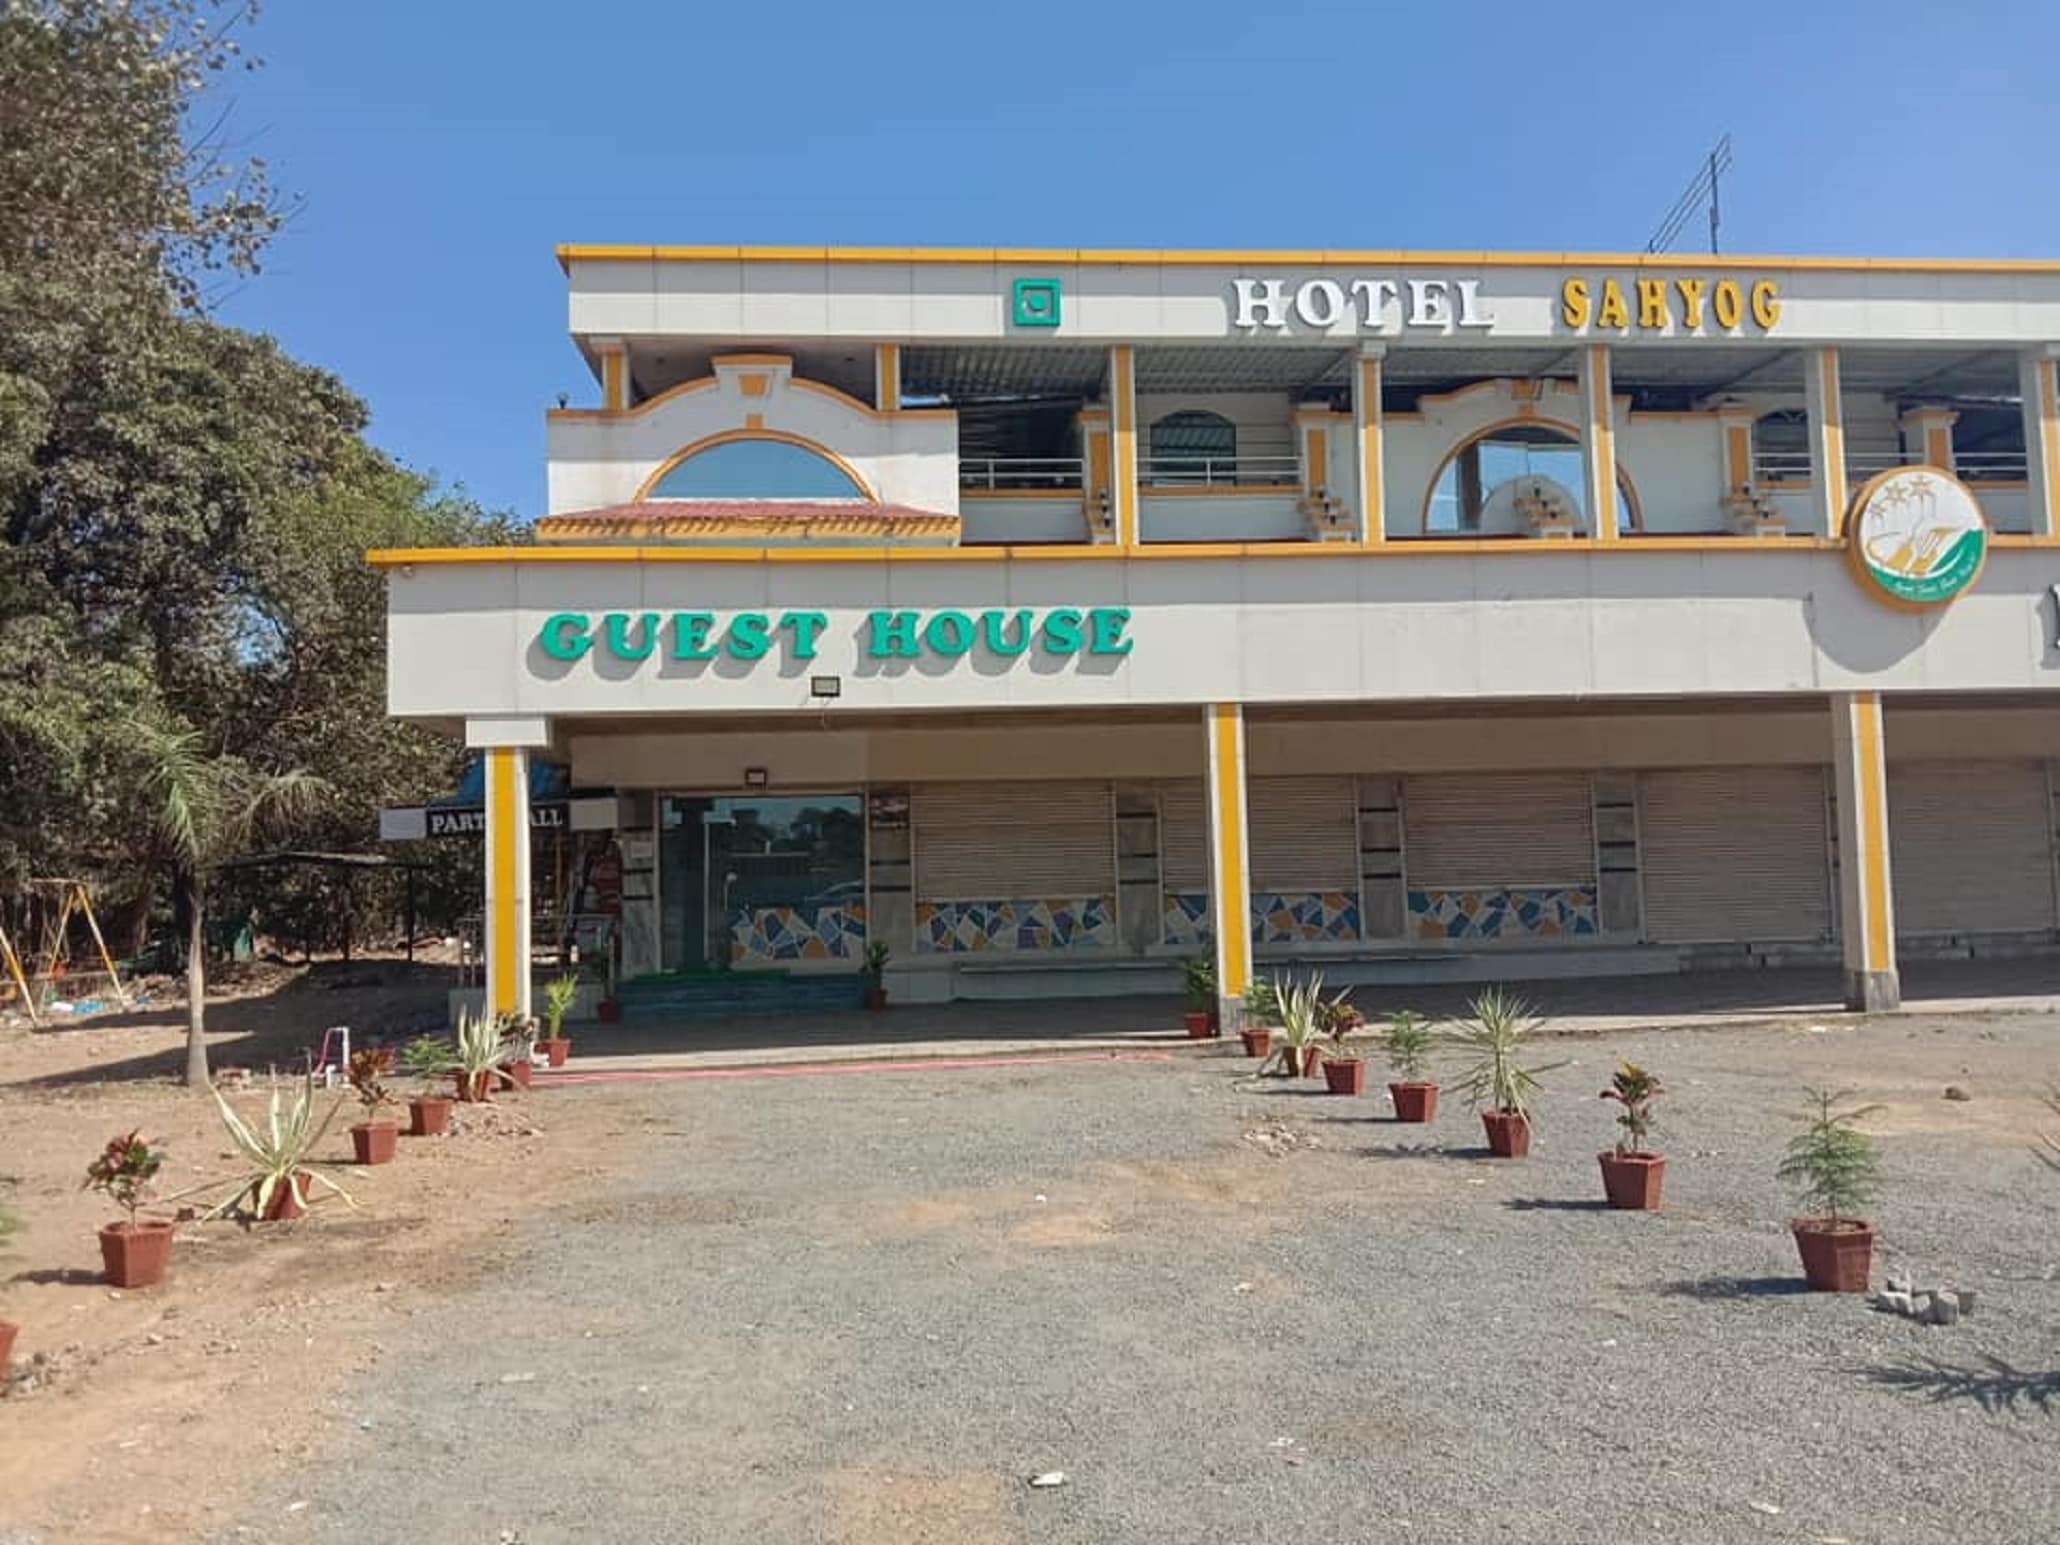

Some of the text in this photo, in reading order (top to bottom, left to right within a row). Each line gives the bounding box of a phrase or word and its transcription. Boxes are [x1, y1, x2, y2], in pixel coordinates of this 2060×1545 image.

[1232, 276, 1783, 329] HOTEL SAHYOG
[541, 607, 1133, 662] GUEST HOUSE
[432, 811, 485, 833] PART
